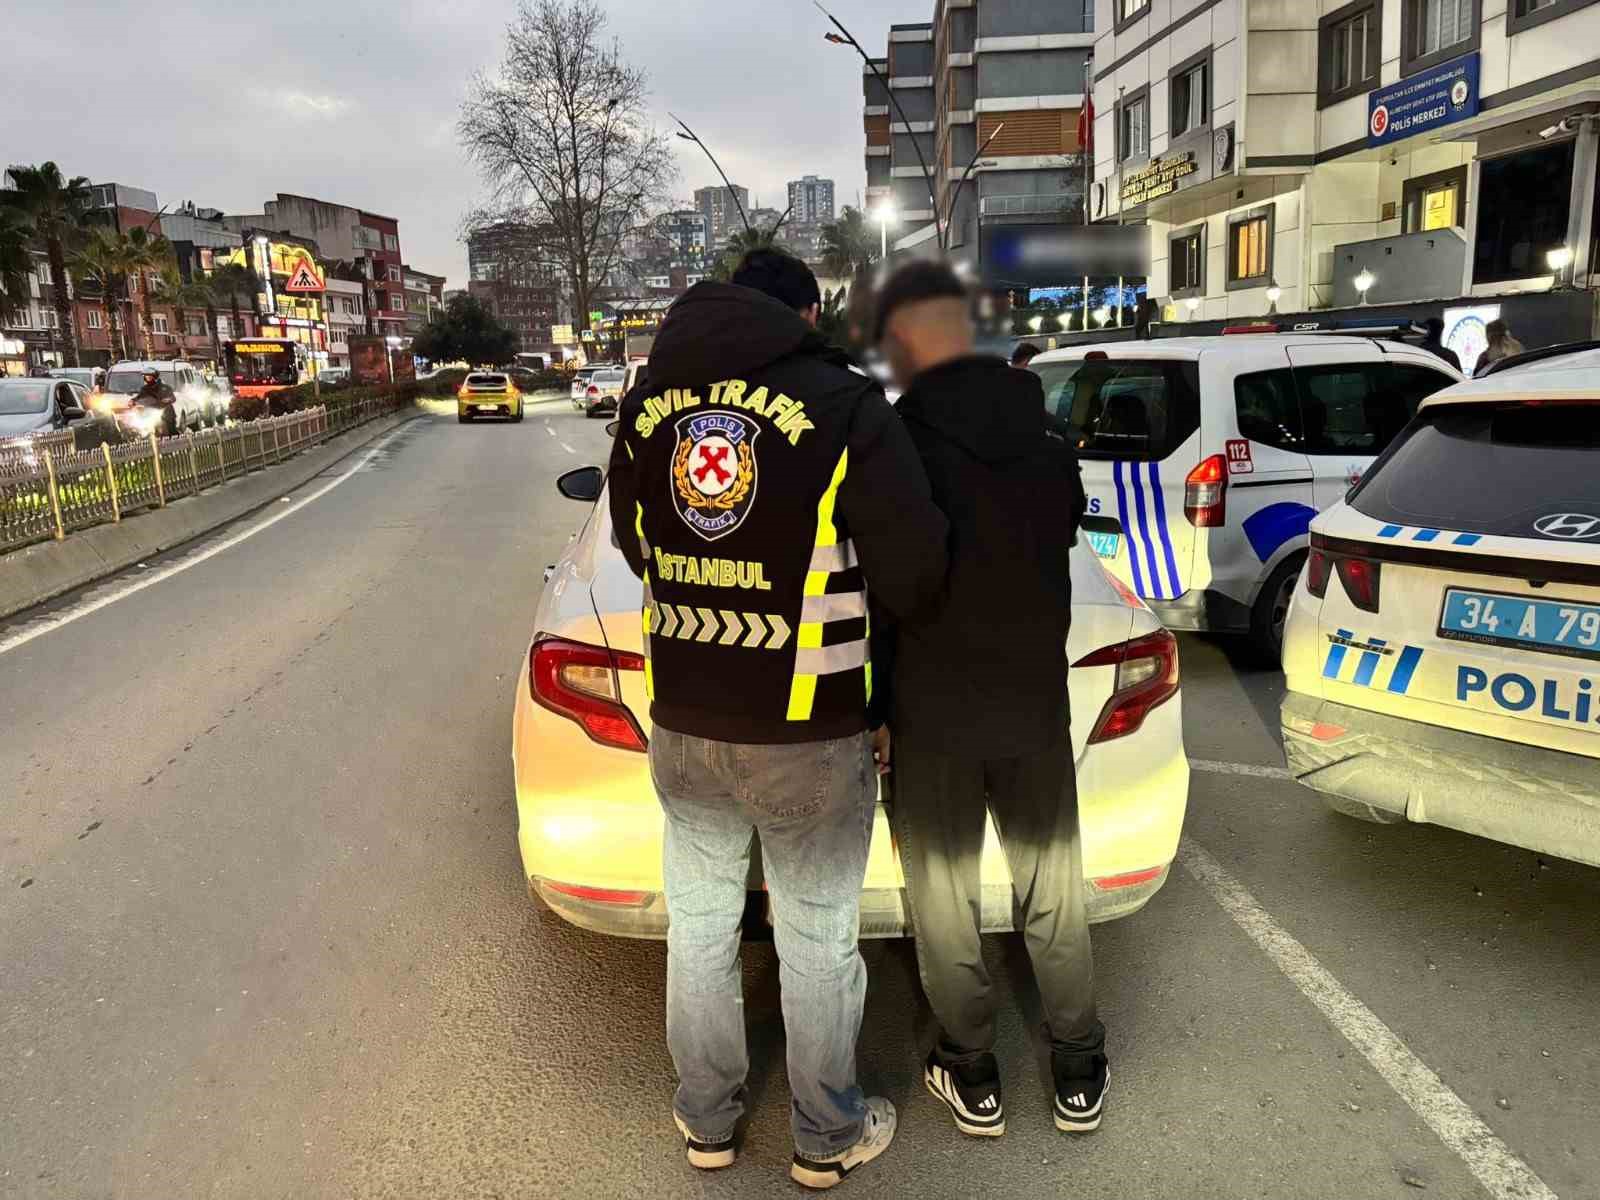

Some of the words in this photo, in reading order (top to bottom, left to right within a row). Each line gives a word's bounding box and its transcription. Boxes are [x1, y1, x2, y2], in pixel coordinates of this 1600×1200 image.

[1411, 103, 1446, 125] MERKEZİ
[1294, 322, 1320, 331] CSR
[635, 387, 701, 439] SİVİL
[708, 378, 816, 446] TRAFİK
[1229, 443, 1248, 460] 112
[654, 546, 772, 591] İSTANBUL
[1460, 597, 1499, 633] 34
[1517, 604, 1537, 639] A
